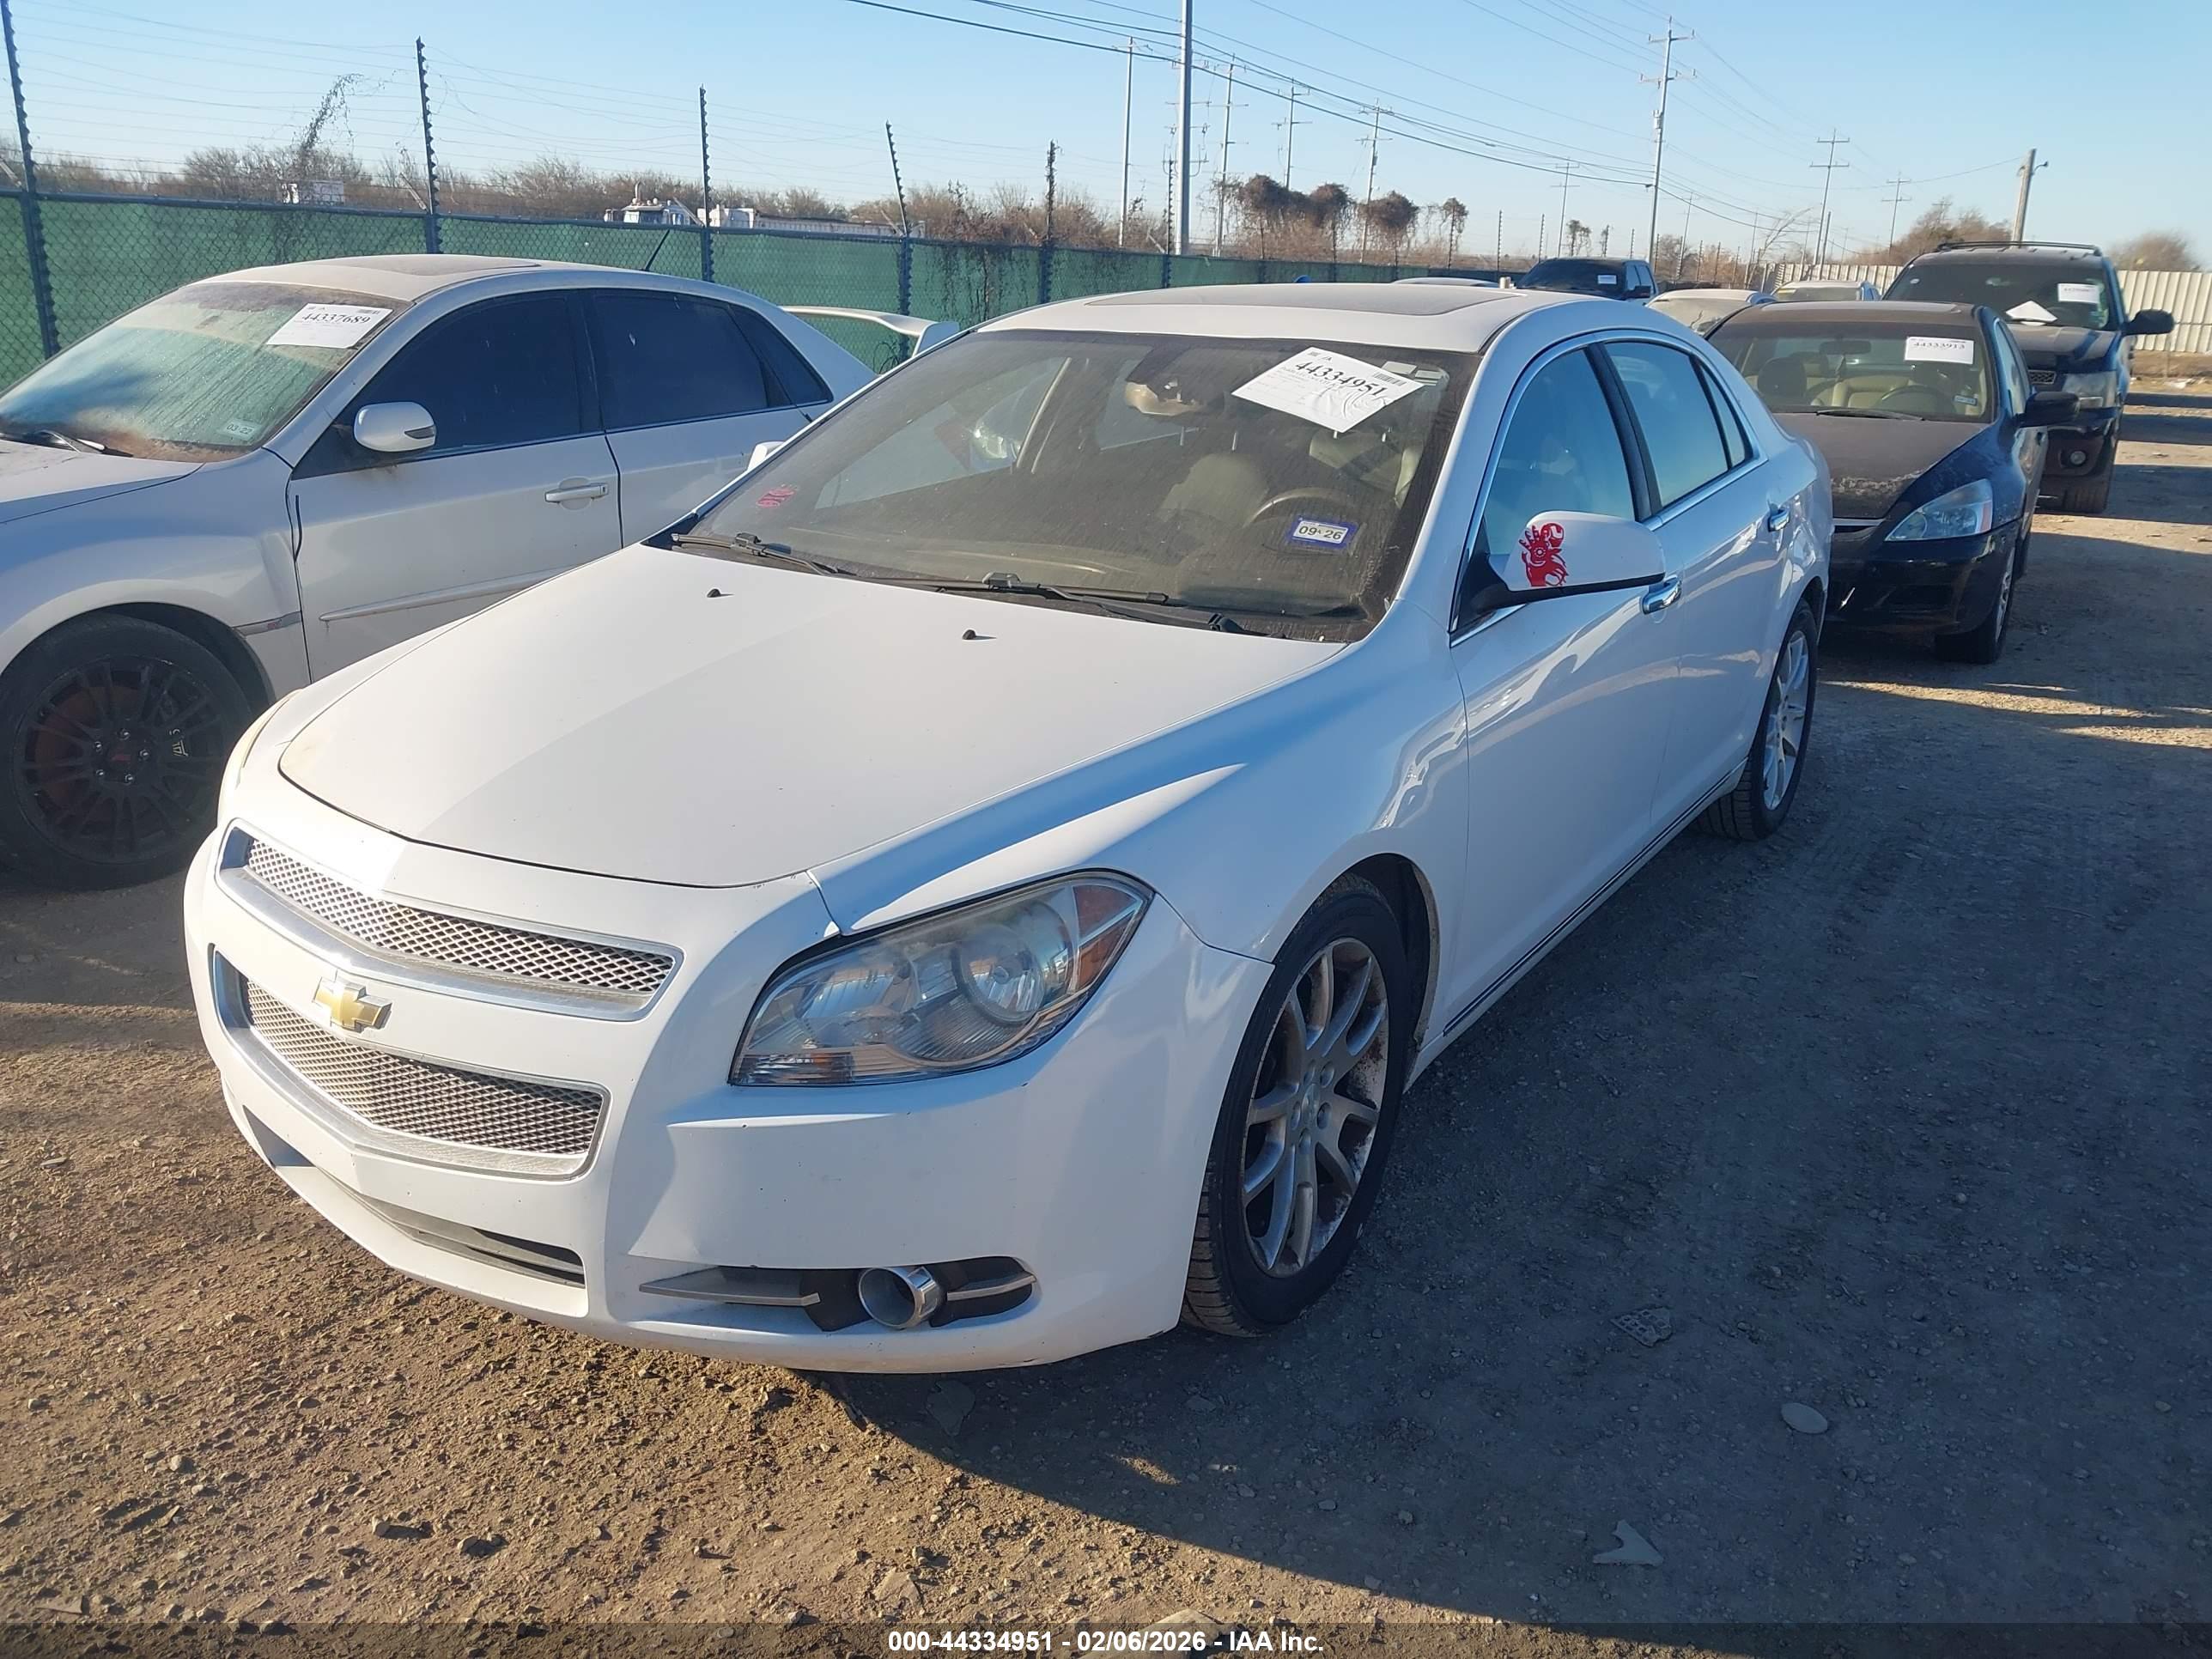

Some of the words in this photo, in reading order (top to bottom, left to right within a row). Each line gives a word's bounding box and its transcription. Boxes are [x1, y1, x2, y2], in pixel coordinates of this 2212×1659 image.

[302, 313, 371, 324] 44337689
[1295, 362, 1388, 396] 44334951
[1323, 529, 1344, 540] 26
